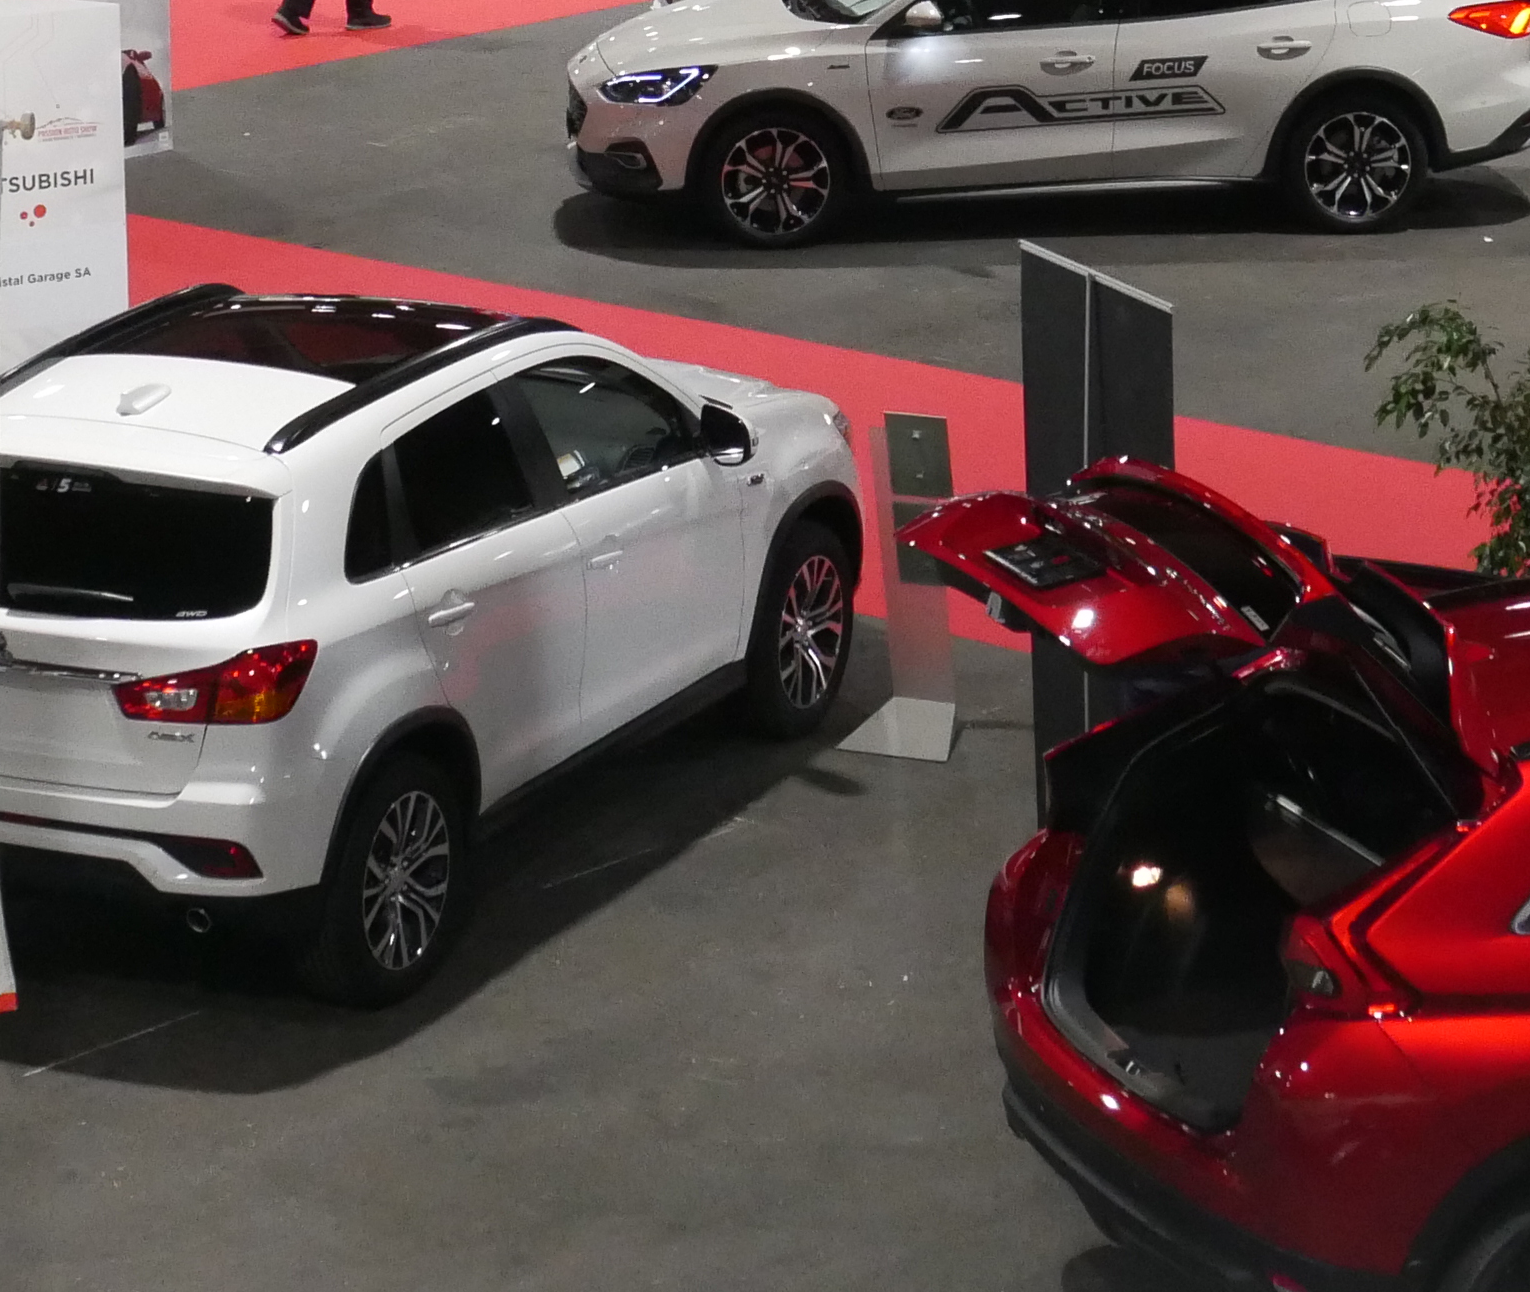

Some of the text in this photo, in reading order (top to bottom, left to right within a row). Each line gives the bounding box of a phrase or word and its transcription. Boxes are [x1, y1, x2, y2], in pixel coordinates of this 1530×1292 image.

[1142, 61, 1195, 76] FOCUS
[939, 87, 1211, 130] ACTIVE
[27, 271, 72, 285] Garage
[74, 266, 92, 279] SA
